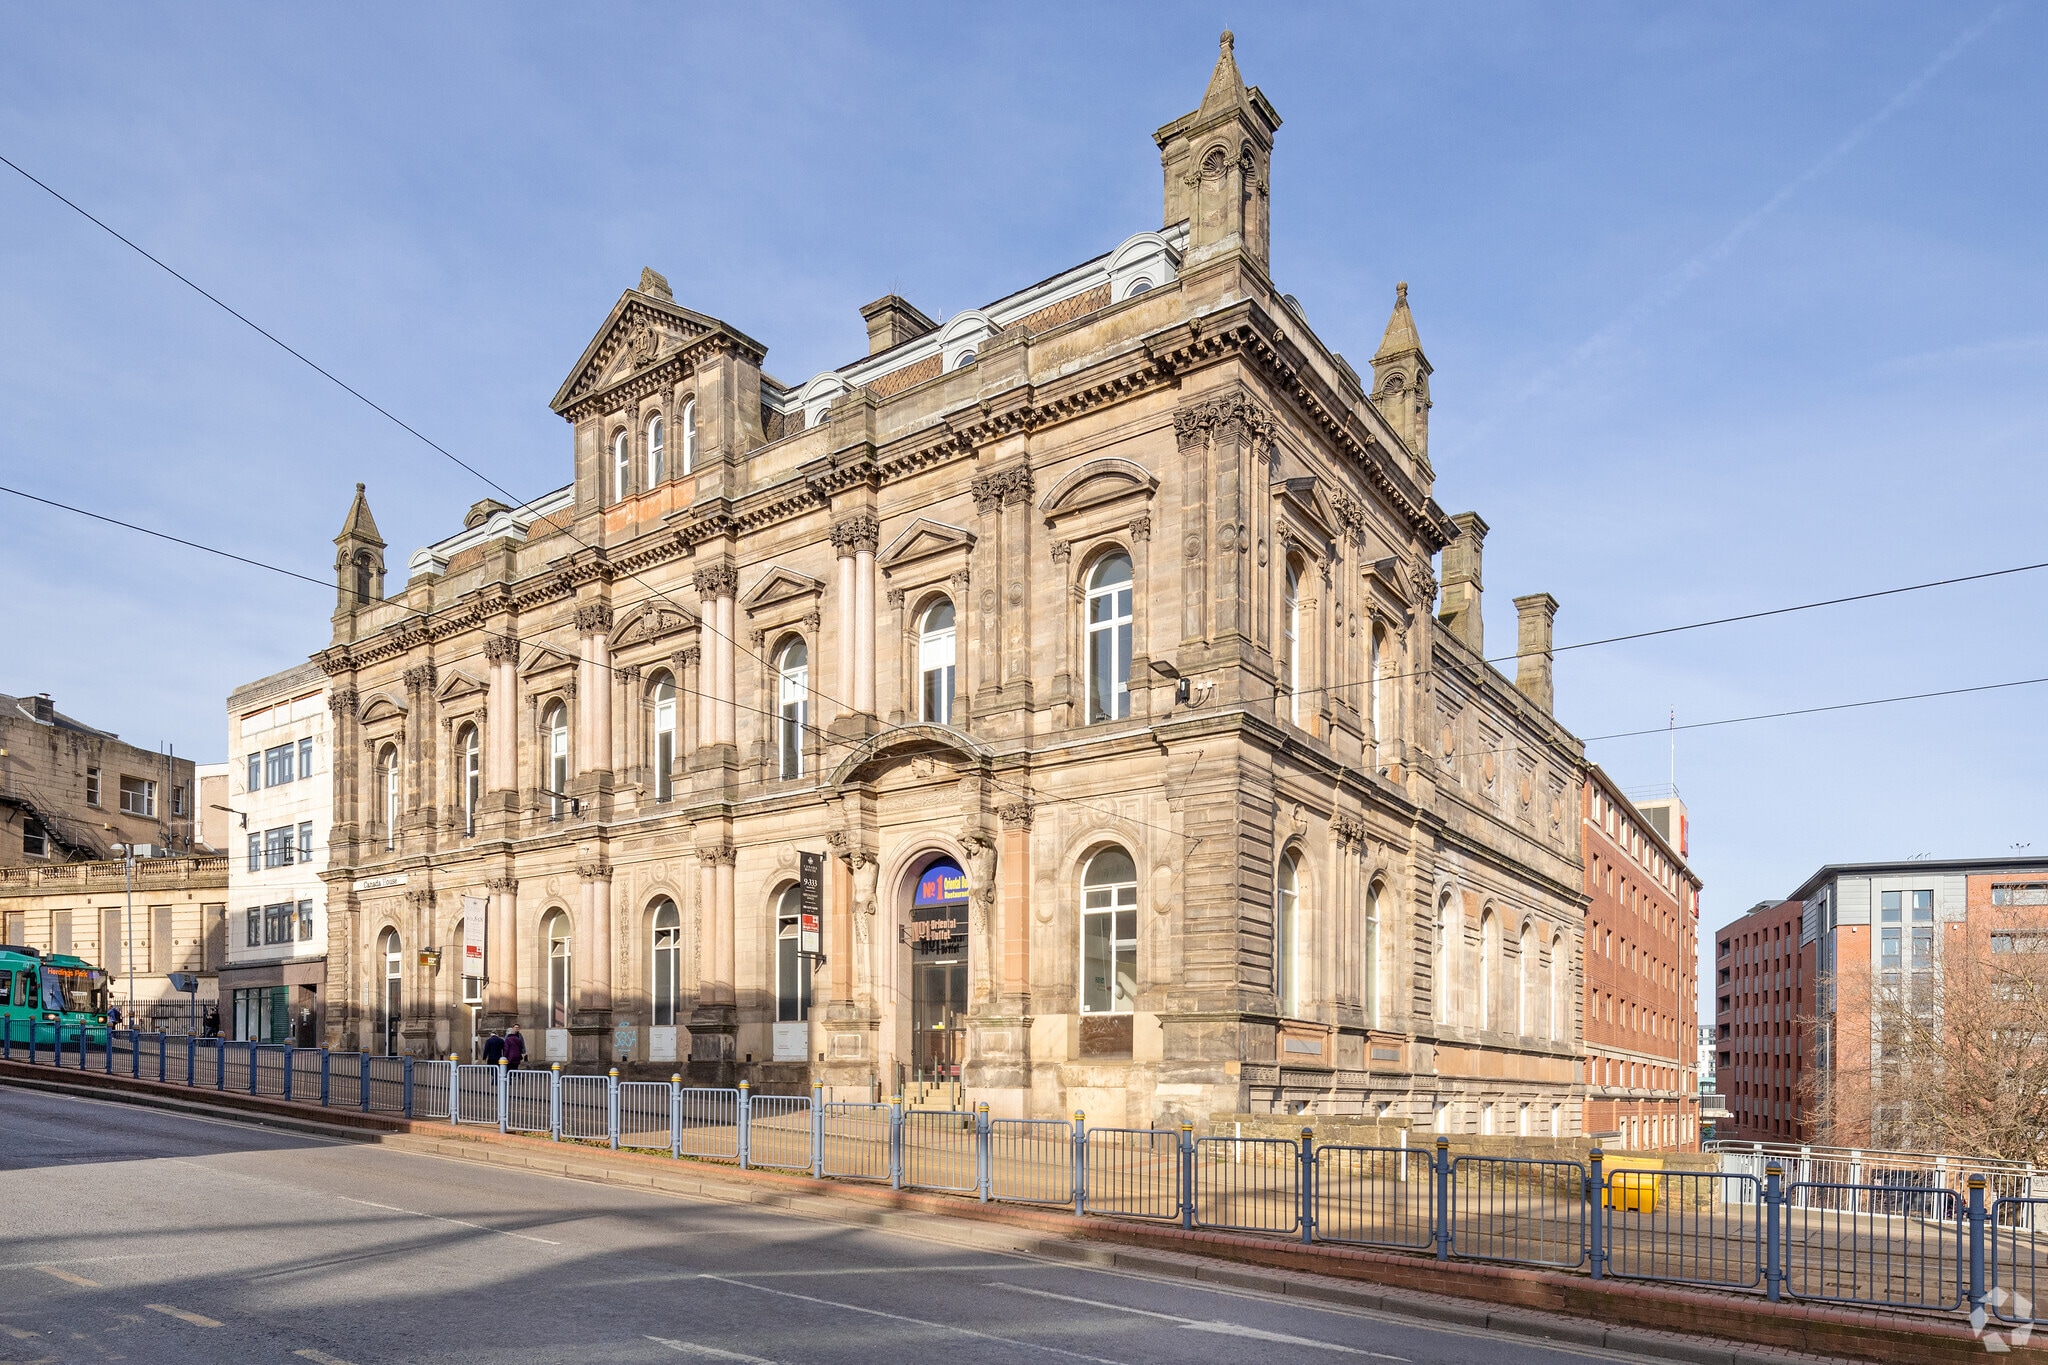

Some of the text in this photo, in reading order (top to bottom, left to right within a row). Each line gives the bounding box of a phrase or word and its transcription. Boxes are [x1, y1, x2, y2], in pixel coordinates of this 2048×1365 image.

[363, 878, 398, 889] Canada House
[944, 876, 961, 890] Oriental
[931, 918, 957, 930] Oriental
[931, 929, 951, 941] Buffet
[47, 968, 73, 977] Herdings
